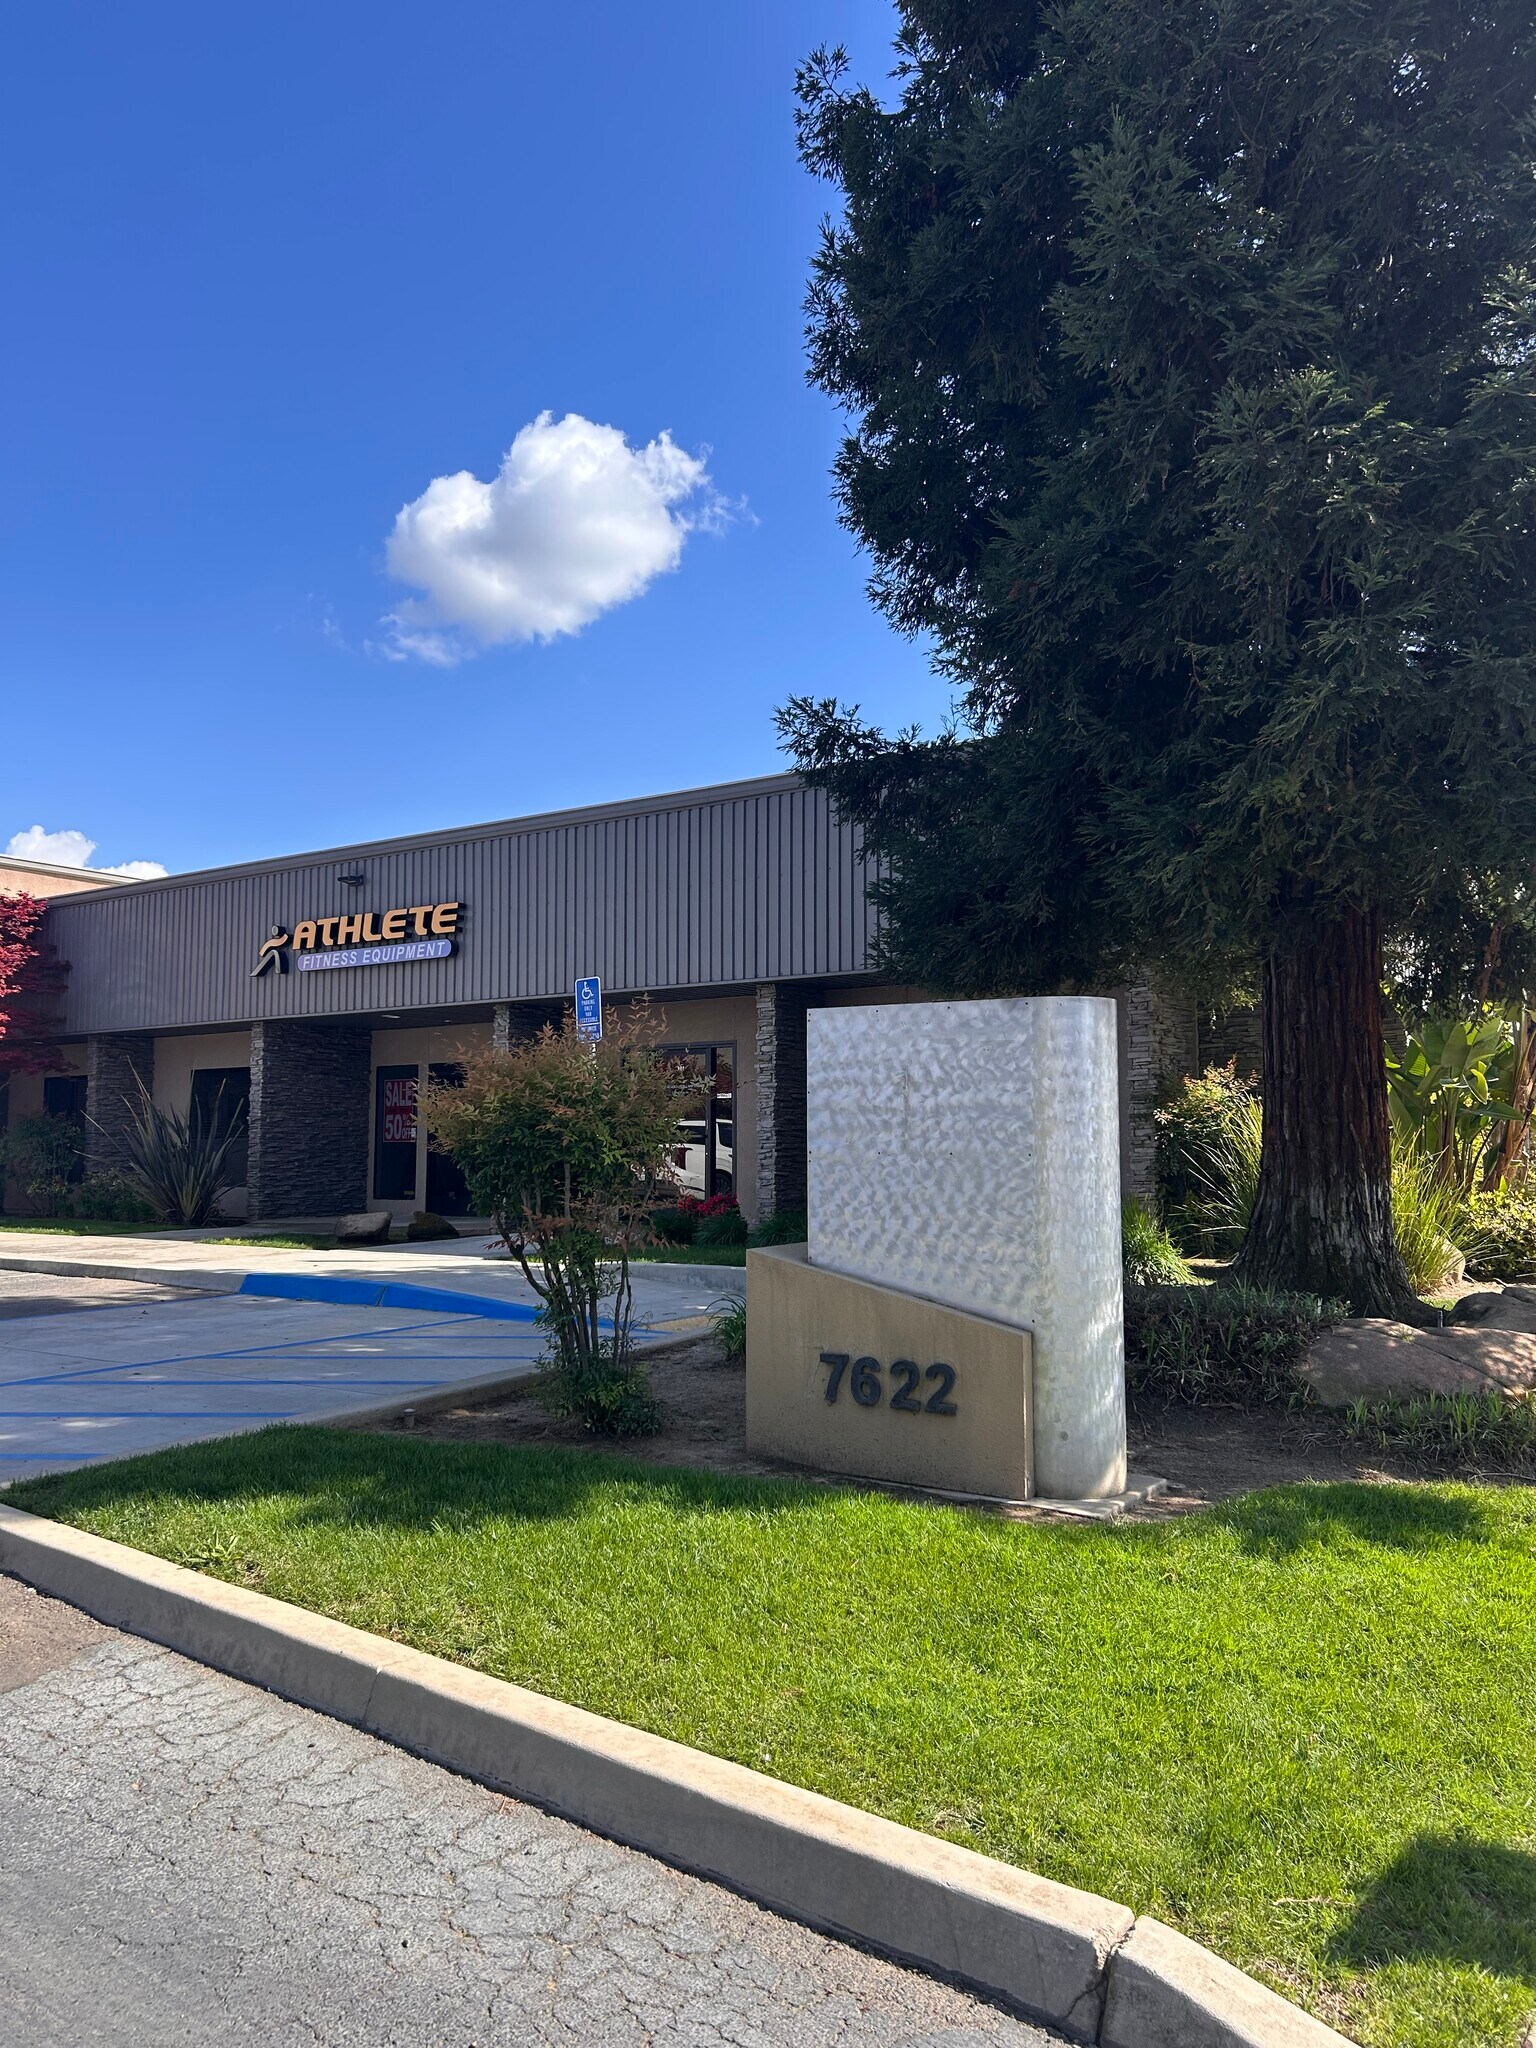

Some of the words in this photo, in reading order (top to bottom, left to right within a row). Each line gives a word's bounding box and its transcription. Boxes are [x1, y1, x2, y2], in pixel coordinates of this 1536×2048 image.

[293, 902, 458, 949] ATHLETE
[303, 952, 357, 969] FITNESS
[362, 942, 446, 962] EQUIPMENT
[385, 1081, 412, 1107] SALE
[819, 1353, 958, 1416] 7622
